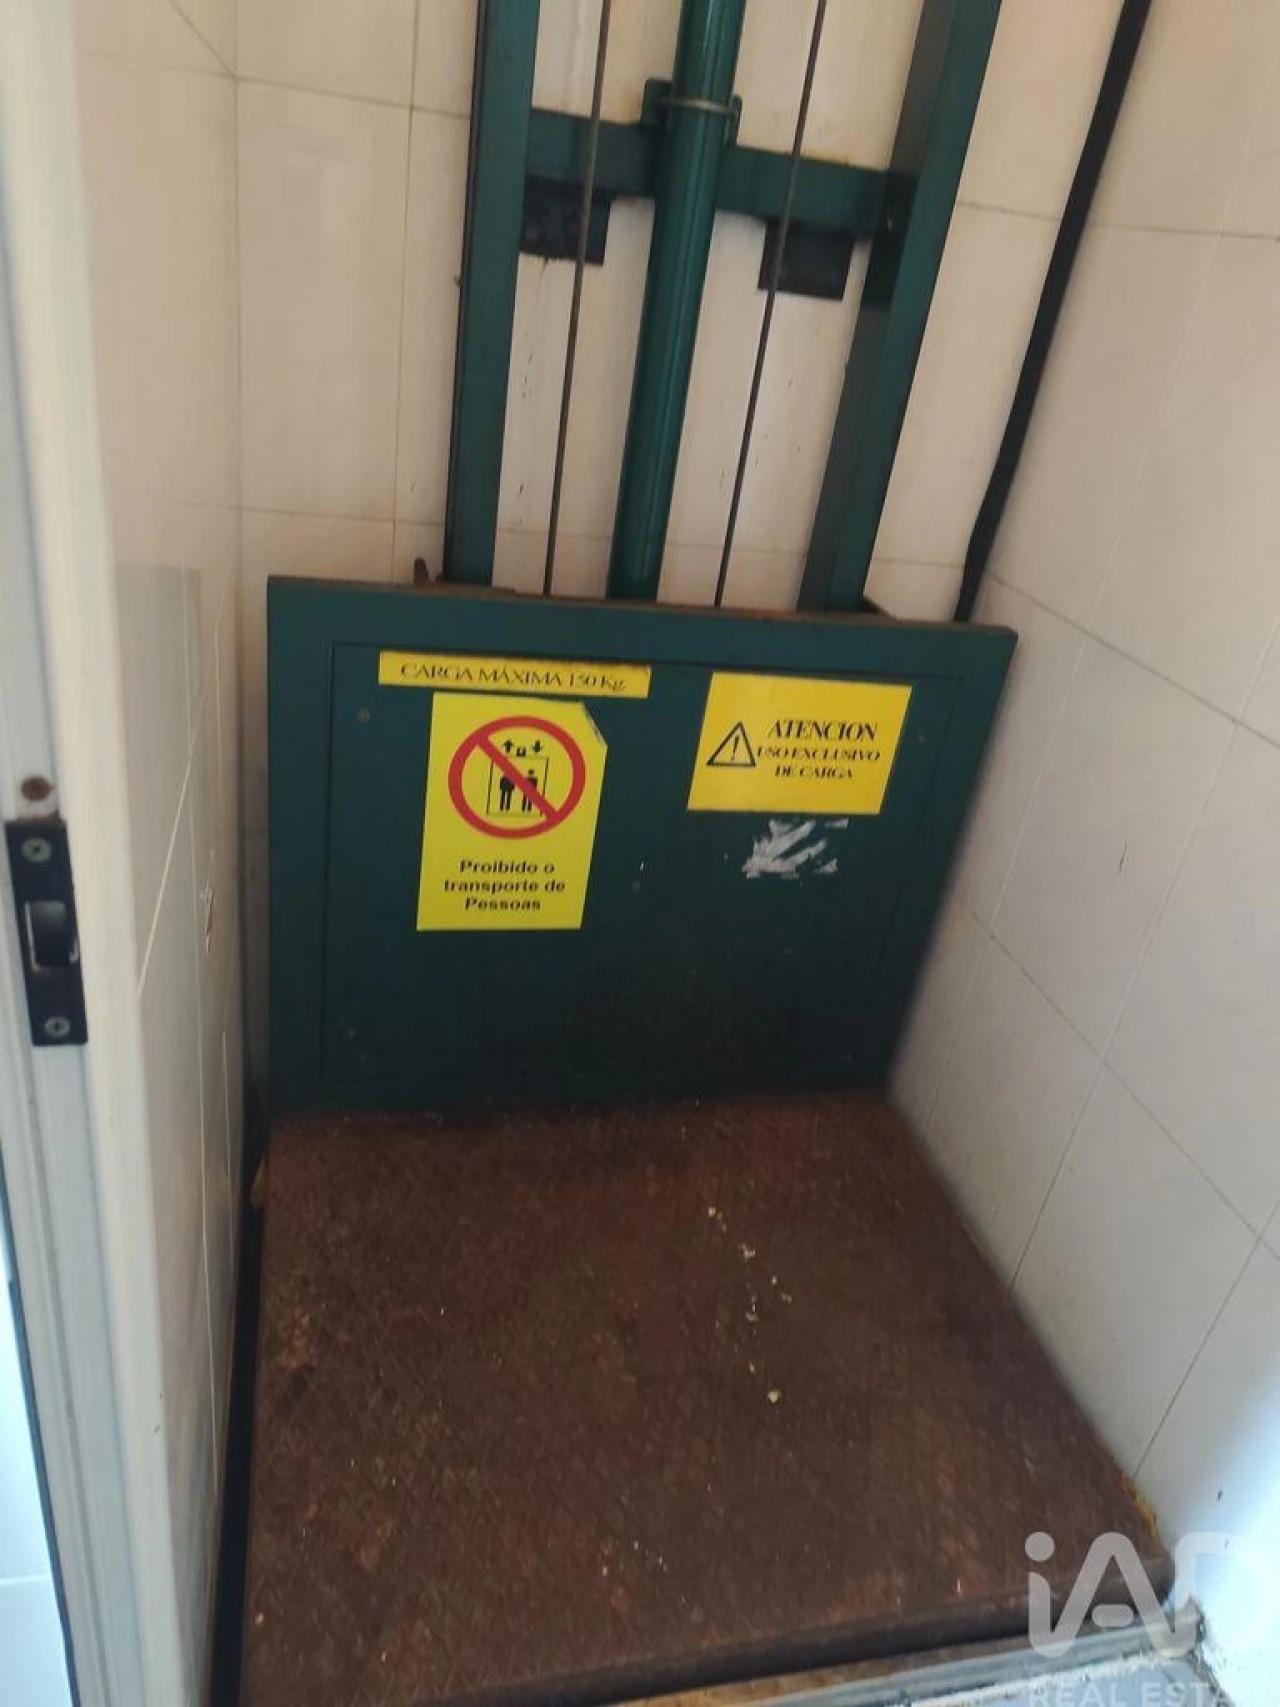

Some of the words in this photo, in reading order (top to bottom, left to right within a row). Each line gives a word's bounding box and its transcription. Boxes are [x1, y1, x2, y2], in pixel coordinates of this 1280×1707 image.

[400, 663, 473, 681] CARGA
[477, 664, 563, 686] MÁXIMA
[767, 719, 878, 742] ATENCION
[790, 746, 881, 761] EXCLUSIVO
[774, 765, 795, 778] DE
[798, 766, 854, 779] CARGA
[459, 858, 539, 874] Proibido
[543, 862, 556, 874] o
[443, 878, 539, 896] transporte
[544, 878, 567, 893] de
[464, 896, 542, 912] Pessoas
